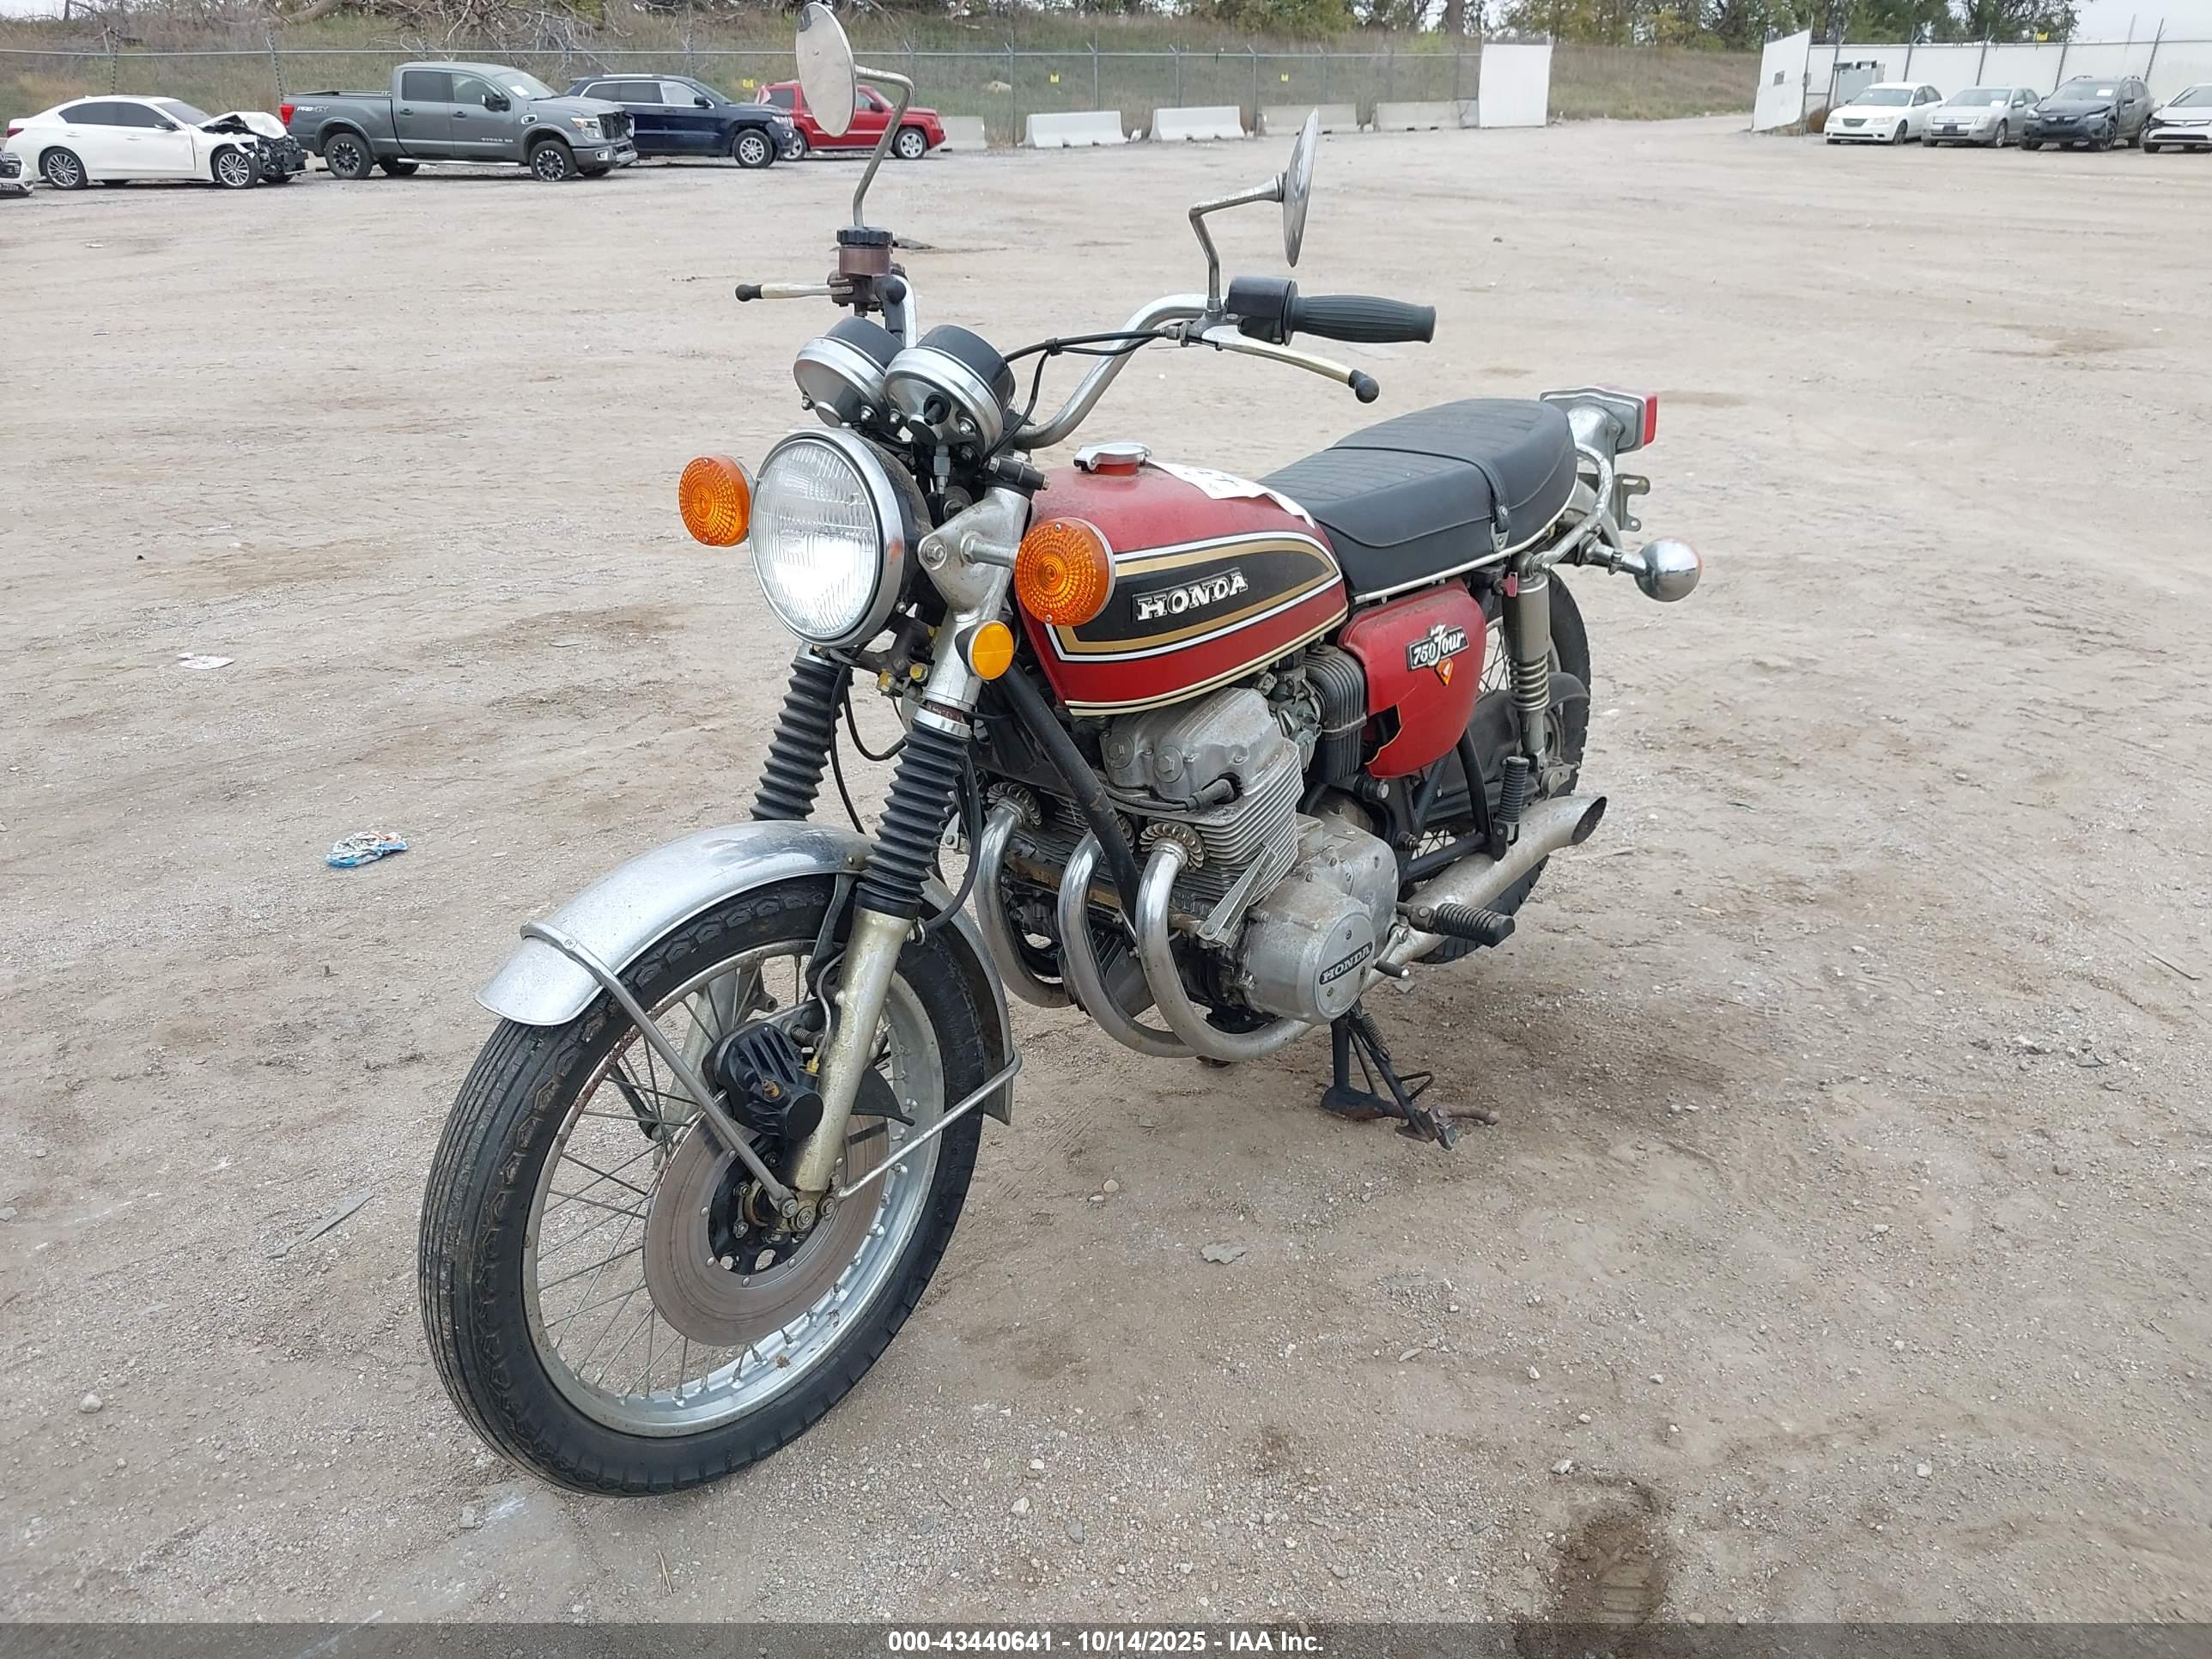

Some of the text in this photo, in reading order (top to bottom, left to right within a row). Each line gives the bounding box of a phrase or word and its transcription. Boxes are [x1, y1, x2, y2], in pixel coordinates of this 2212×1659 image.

[1137, 571, 1249, 621] HONDA
[1413, 624, 1465, 667] 750 Four
[1322, 945, 1370, 983] HONDA
